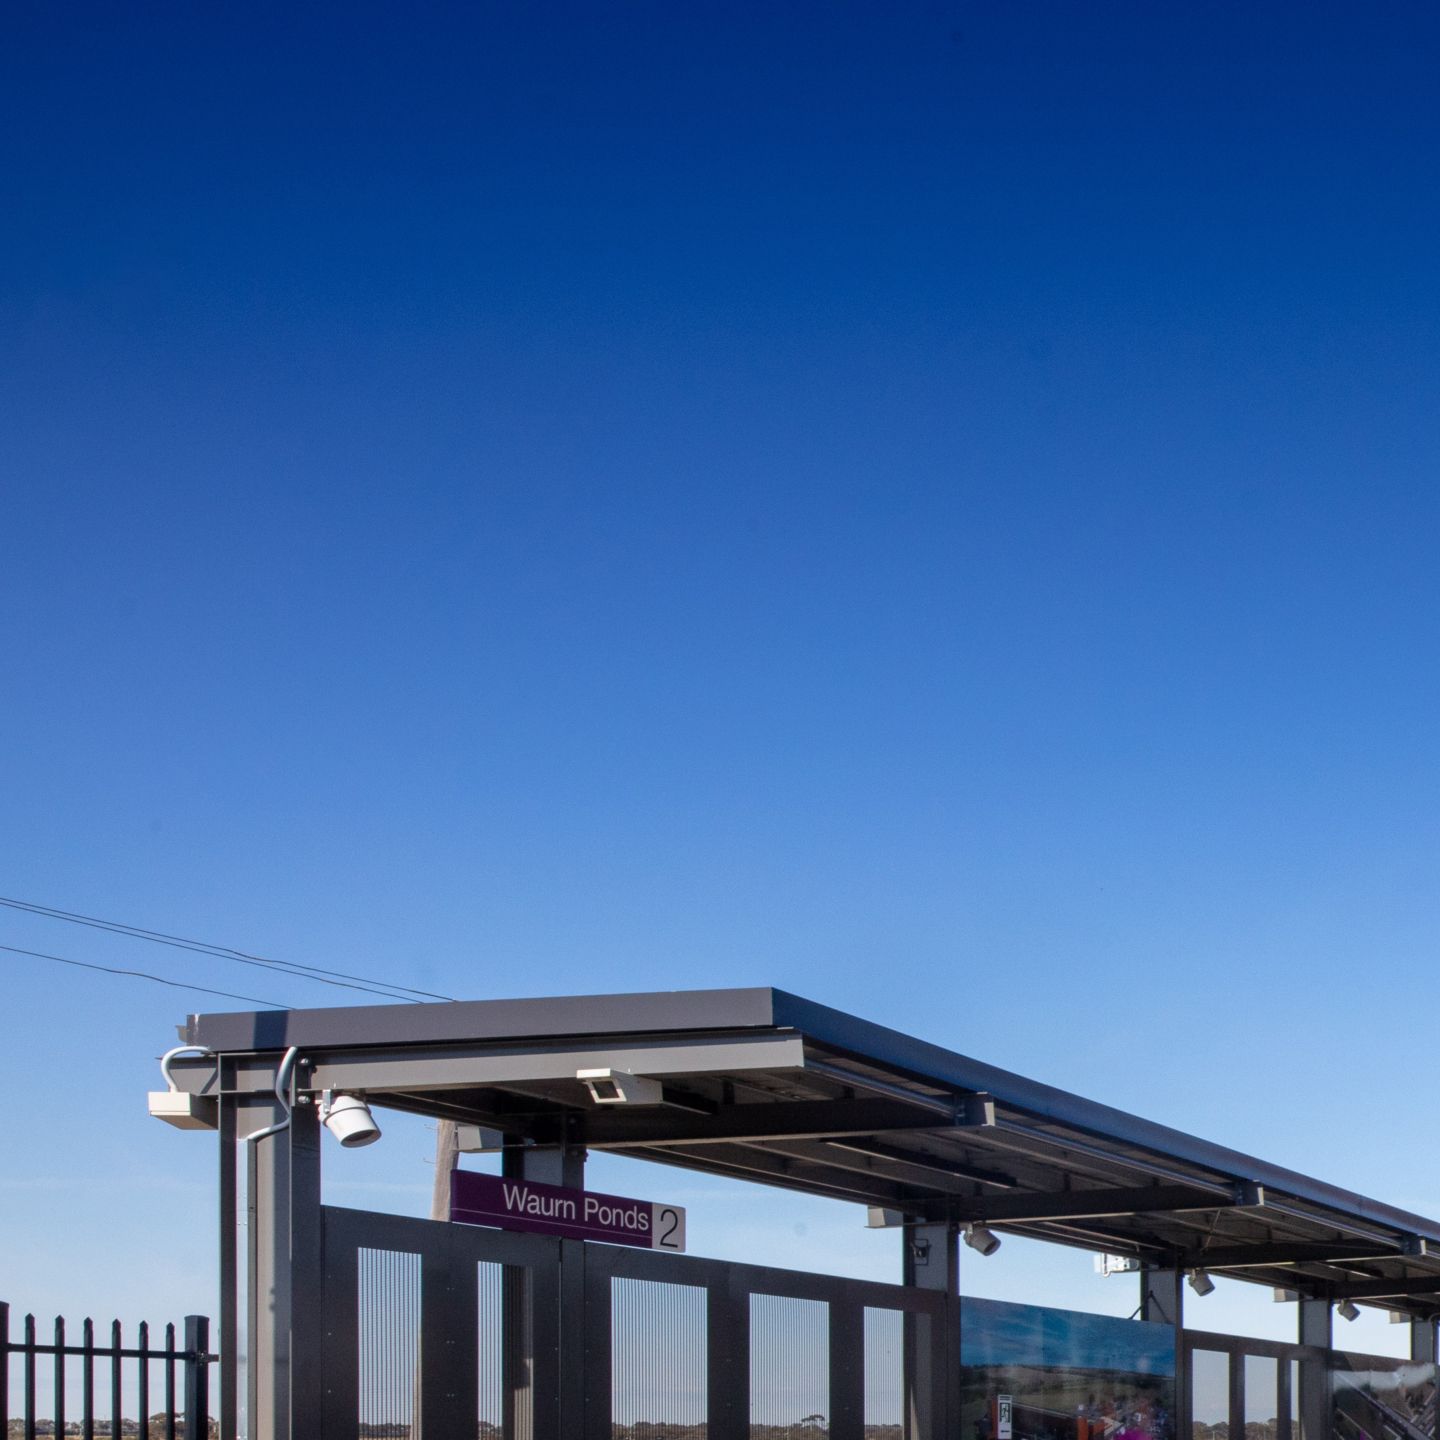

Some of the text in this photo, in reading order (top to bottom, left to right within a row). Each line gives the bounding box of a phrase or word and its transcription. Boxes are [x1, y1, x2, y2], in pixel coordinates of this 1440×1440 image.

[502, 1183, 679, 1248] Waurn Ponds 2
